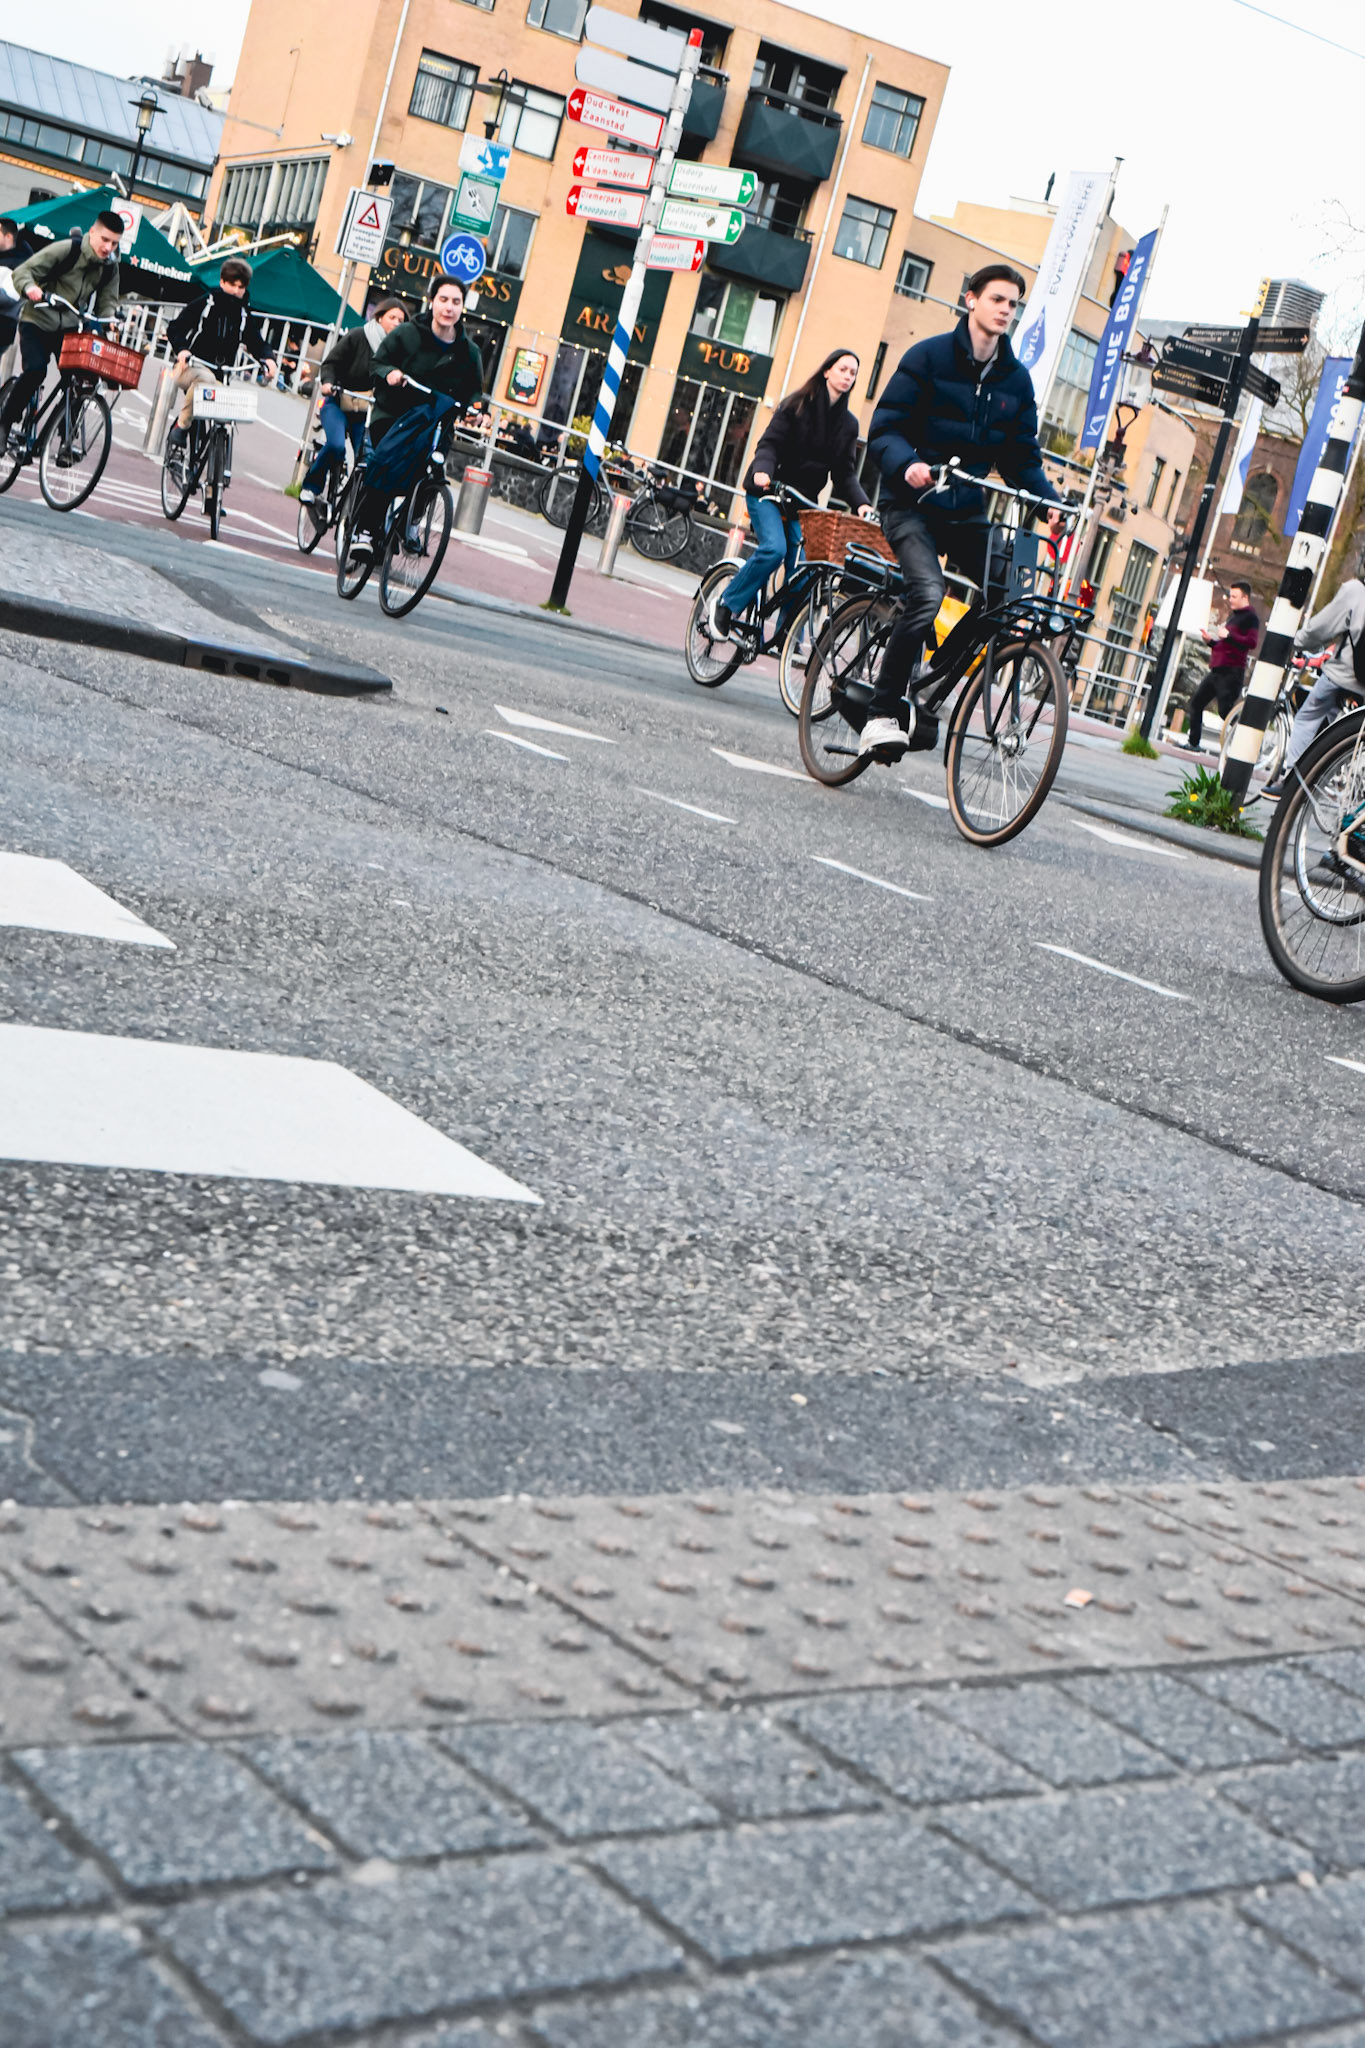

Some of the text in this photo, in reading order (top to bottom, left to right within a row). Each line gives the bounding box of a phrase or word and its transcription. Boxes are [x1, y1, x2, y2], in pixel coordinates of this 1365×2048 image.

[586, 96, 630, 118] Oud-West
[583, 110, 625, 131] Zaanstad
[588, 151, 620, 164] Centrum
[581, 190, 622, 204] Diemerpark
[579, 204, 617, 217] Knooppunt
[139, 256, 193, 282] Heineken
[384, 247, 512, 303] GUINESS
[1114, 255, 1146, 322] BOAT
[576, 306, 648, 344] ARN
[702, 343, 751, 375] PUB
